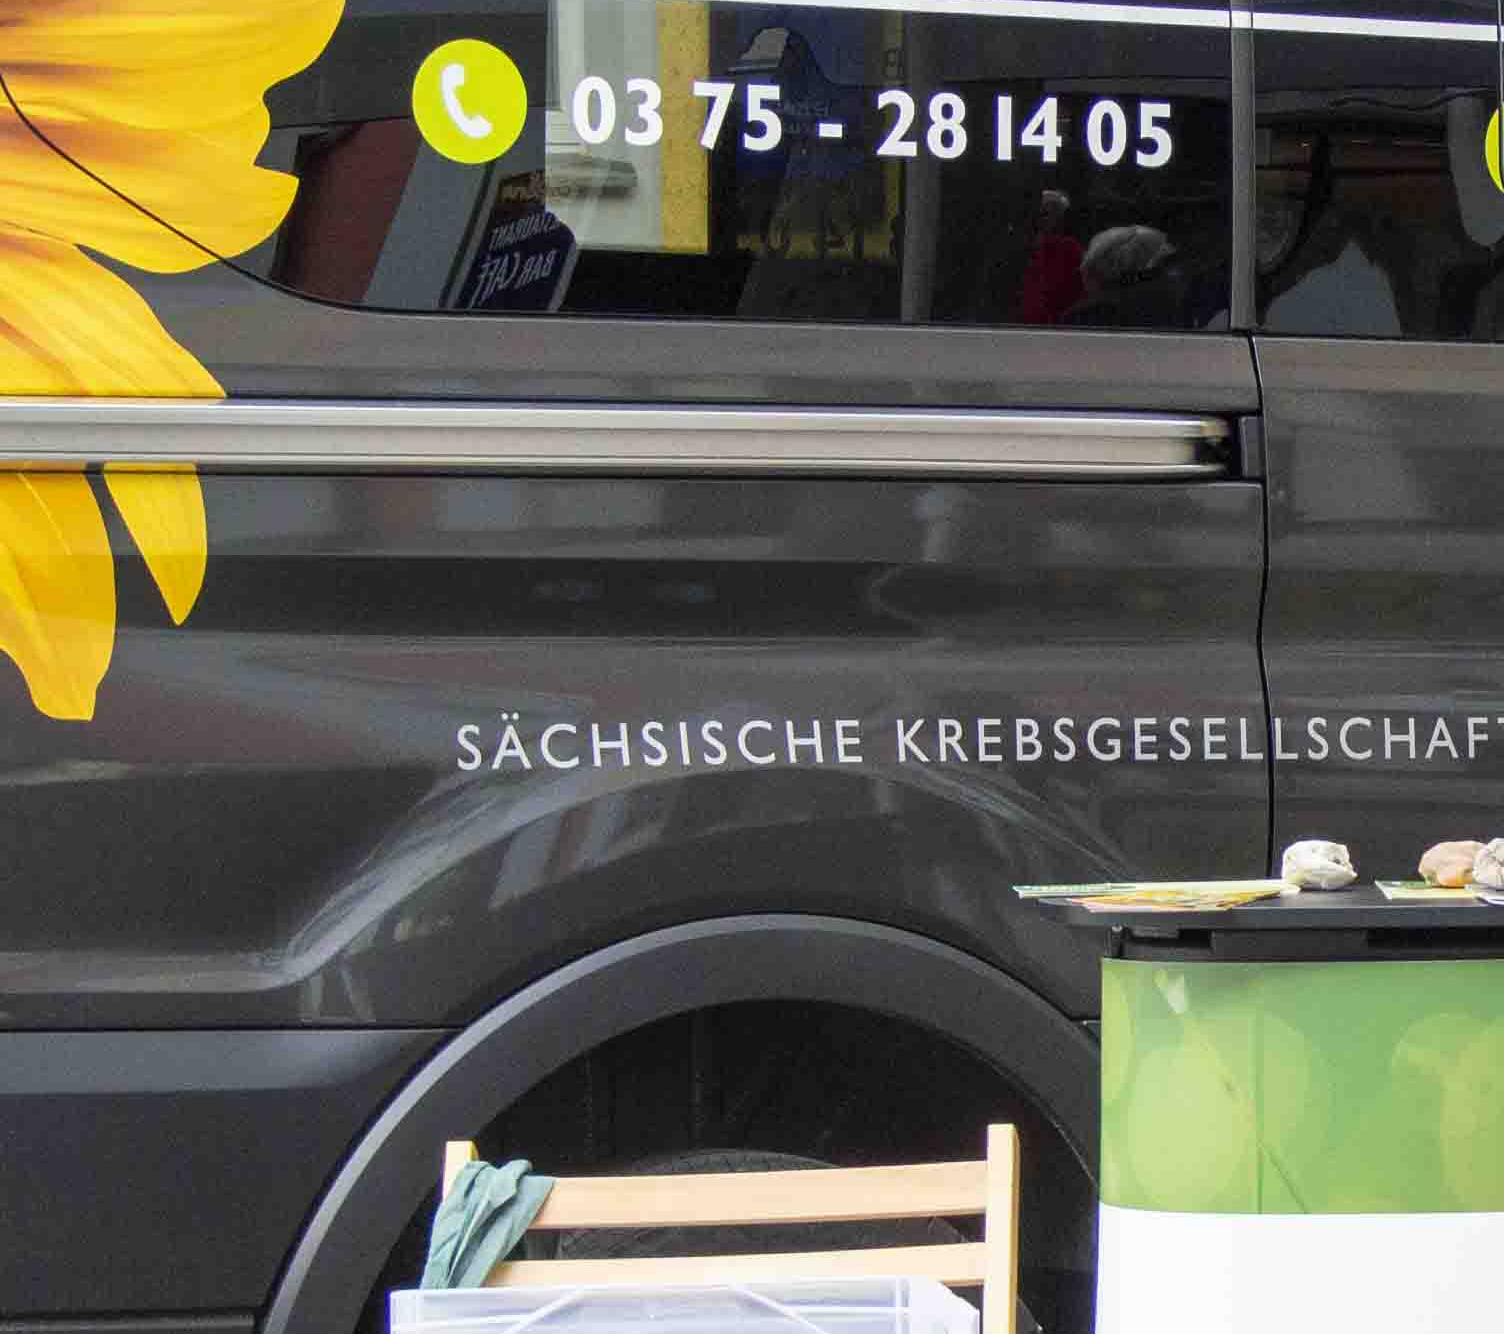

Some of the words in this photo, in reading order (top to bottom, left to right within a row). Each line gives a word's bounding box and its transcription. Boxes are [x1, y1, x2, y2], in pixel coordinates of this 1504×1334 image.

[572, 76, 664, 147] 03
[693, 80, 783, 153] 75
[876, 91, 968, 160] 28
[997, 95, 1061, 164] 14
[1087, 98, 1173, 168] 05
[456, 712, 863, 771] SÄCHSISCHE
